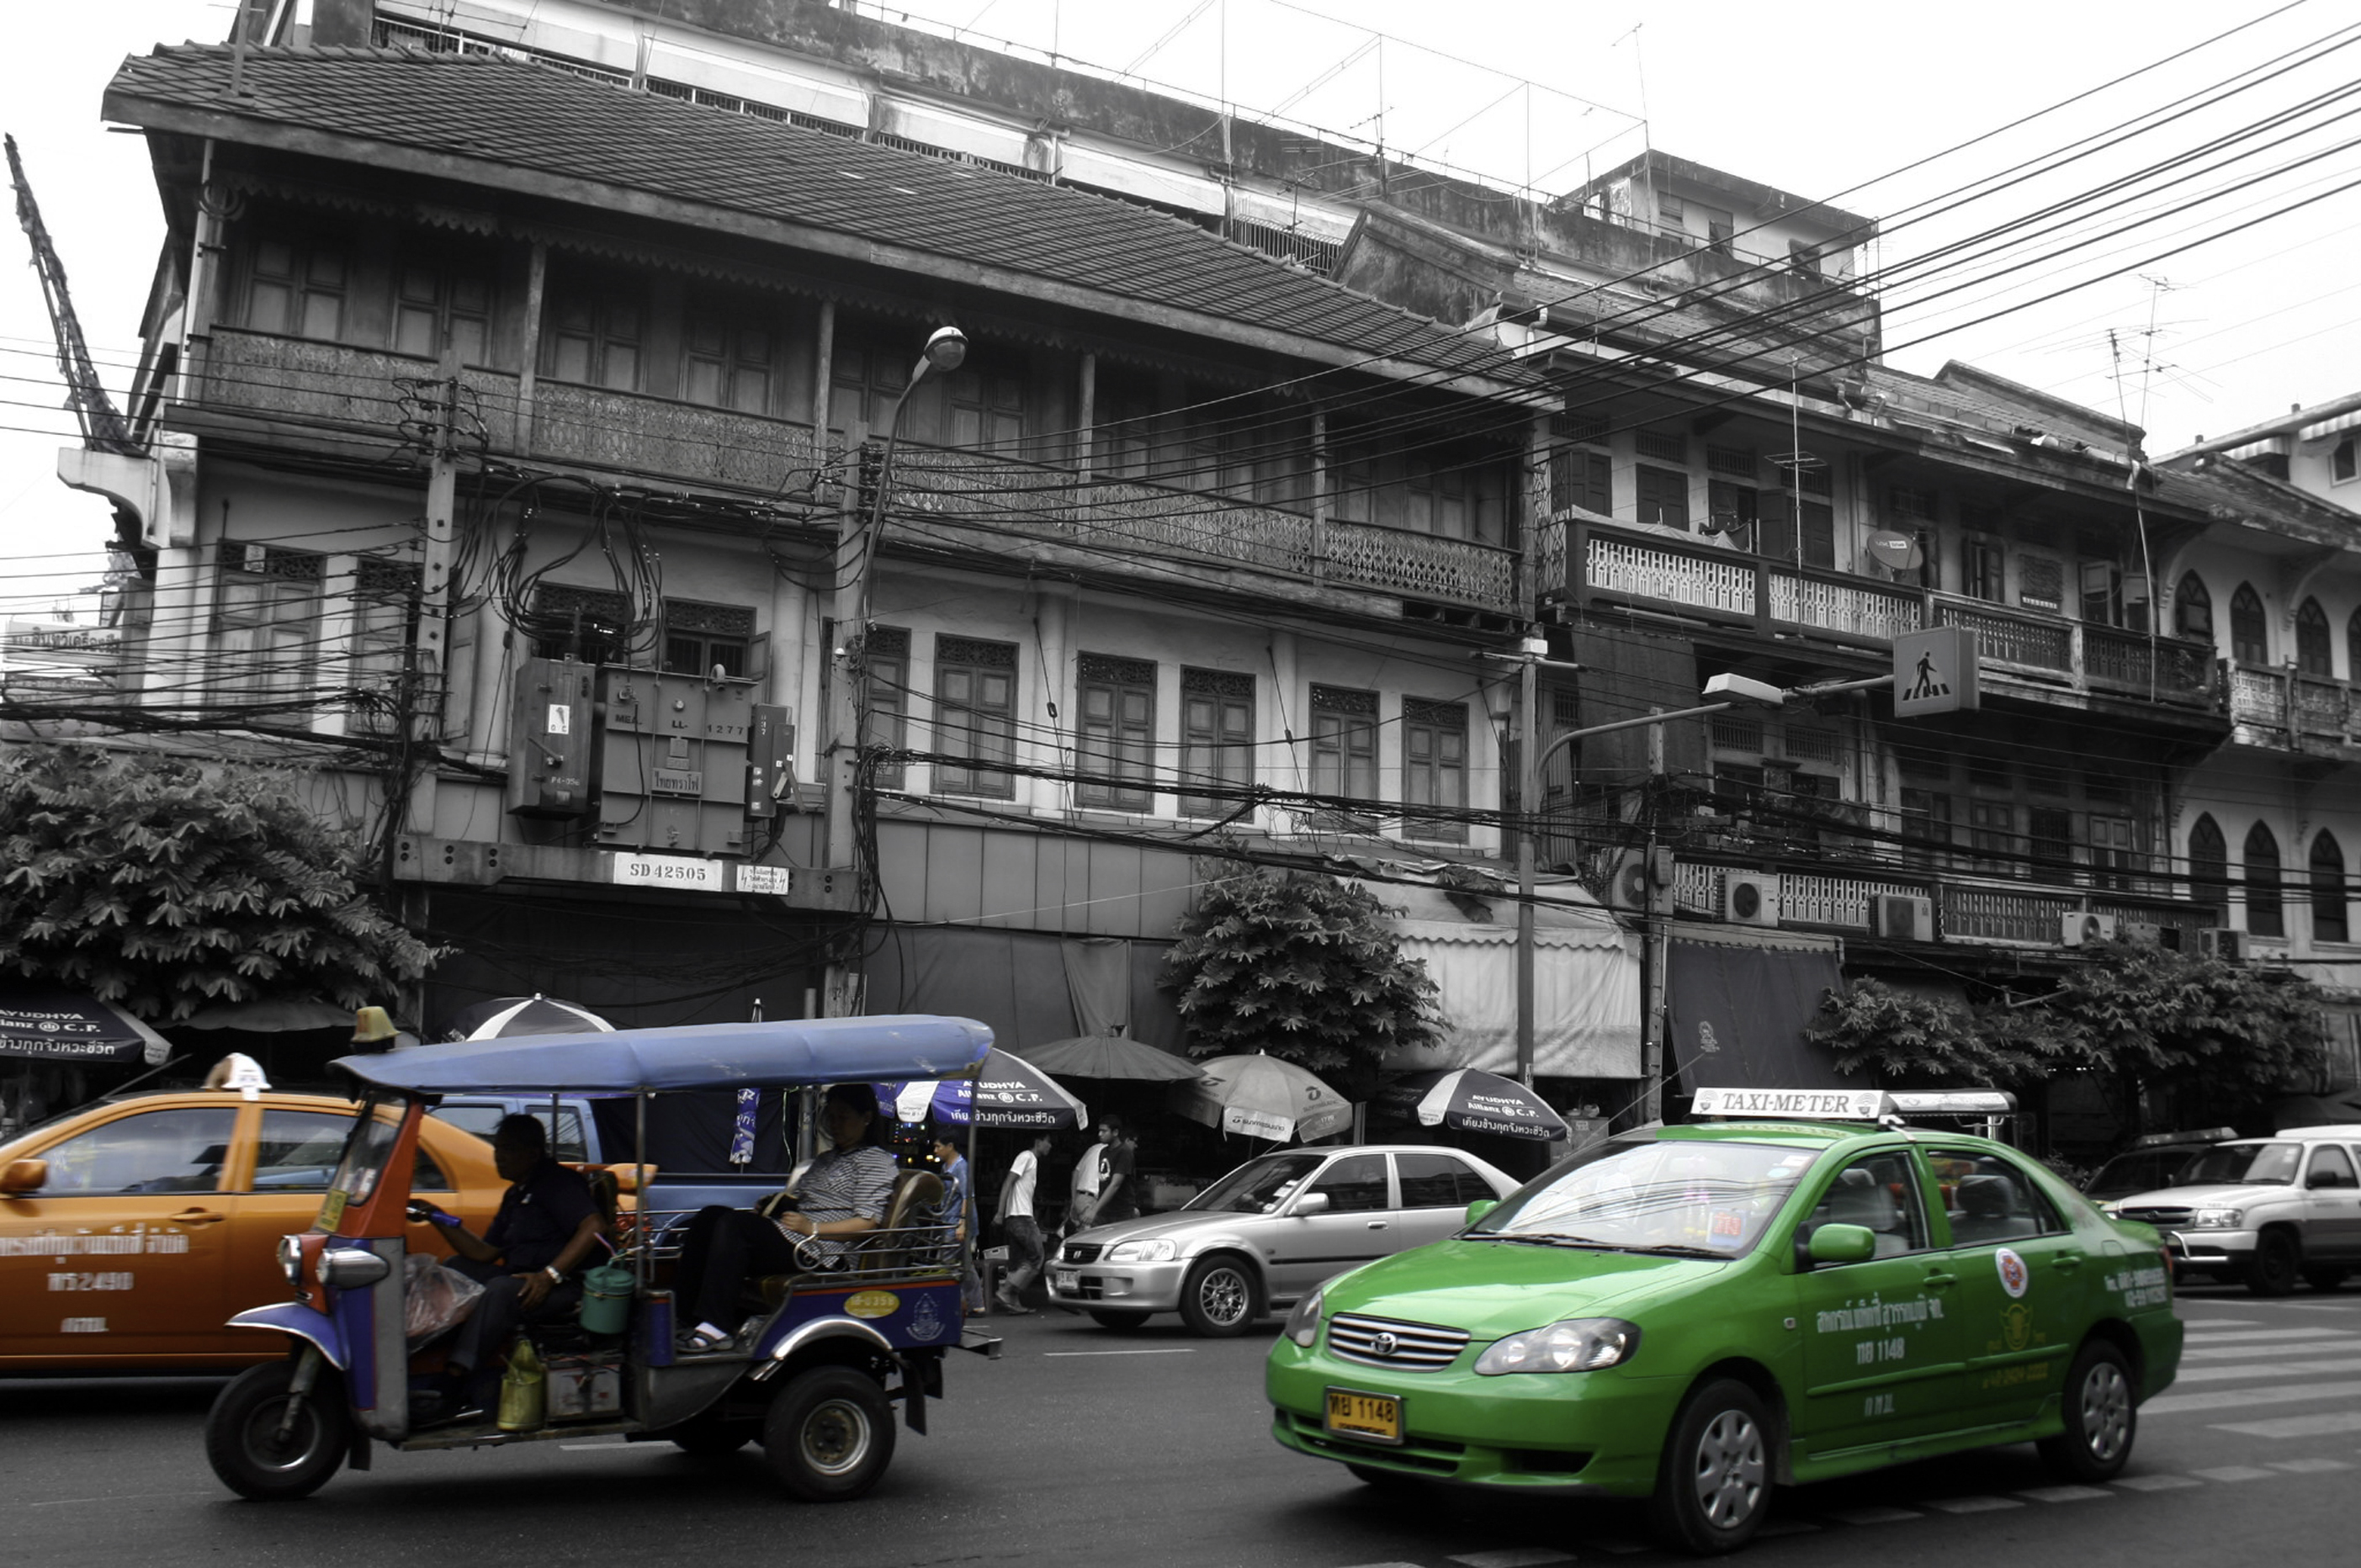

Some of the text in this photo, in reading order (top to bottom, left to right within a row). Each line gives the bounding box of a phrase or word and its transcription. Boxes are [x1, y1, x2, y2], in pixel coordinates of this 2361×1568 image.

[708, 724, 744, 735] 1277
[963, 1081, 1026, 1089] AUDHYA
[958, 1089, 996, 1100] Allanz
[1472, 1094, 1525, 1106] AYUDHYA
[1467, 1102, 1501, 1114] Allianz
[1722, 1093, 1849, 1114] TAXI-METER
[1877, 1337, 1905, 1362] 1148
[1357, 1398, 1395, 1423] 1148
